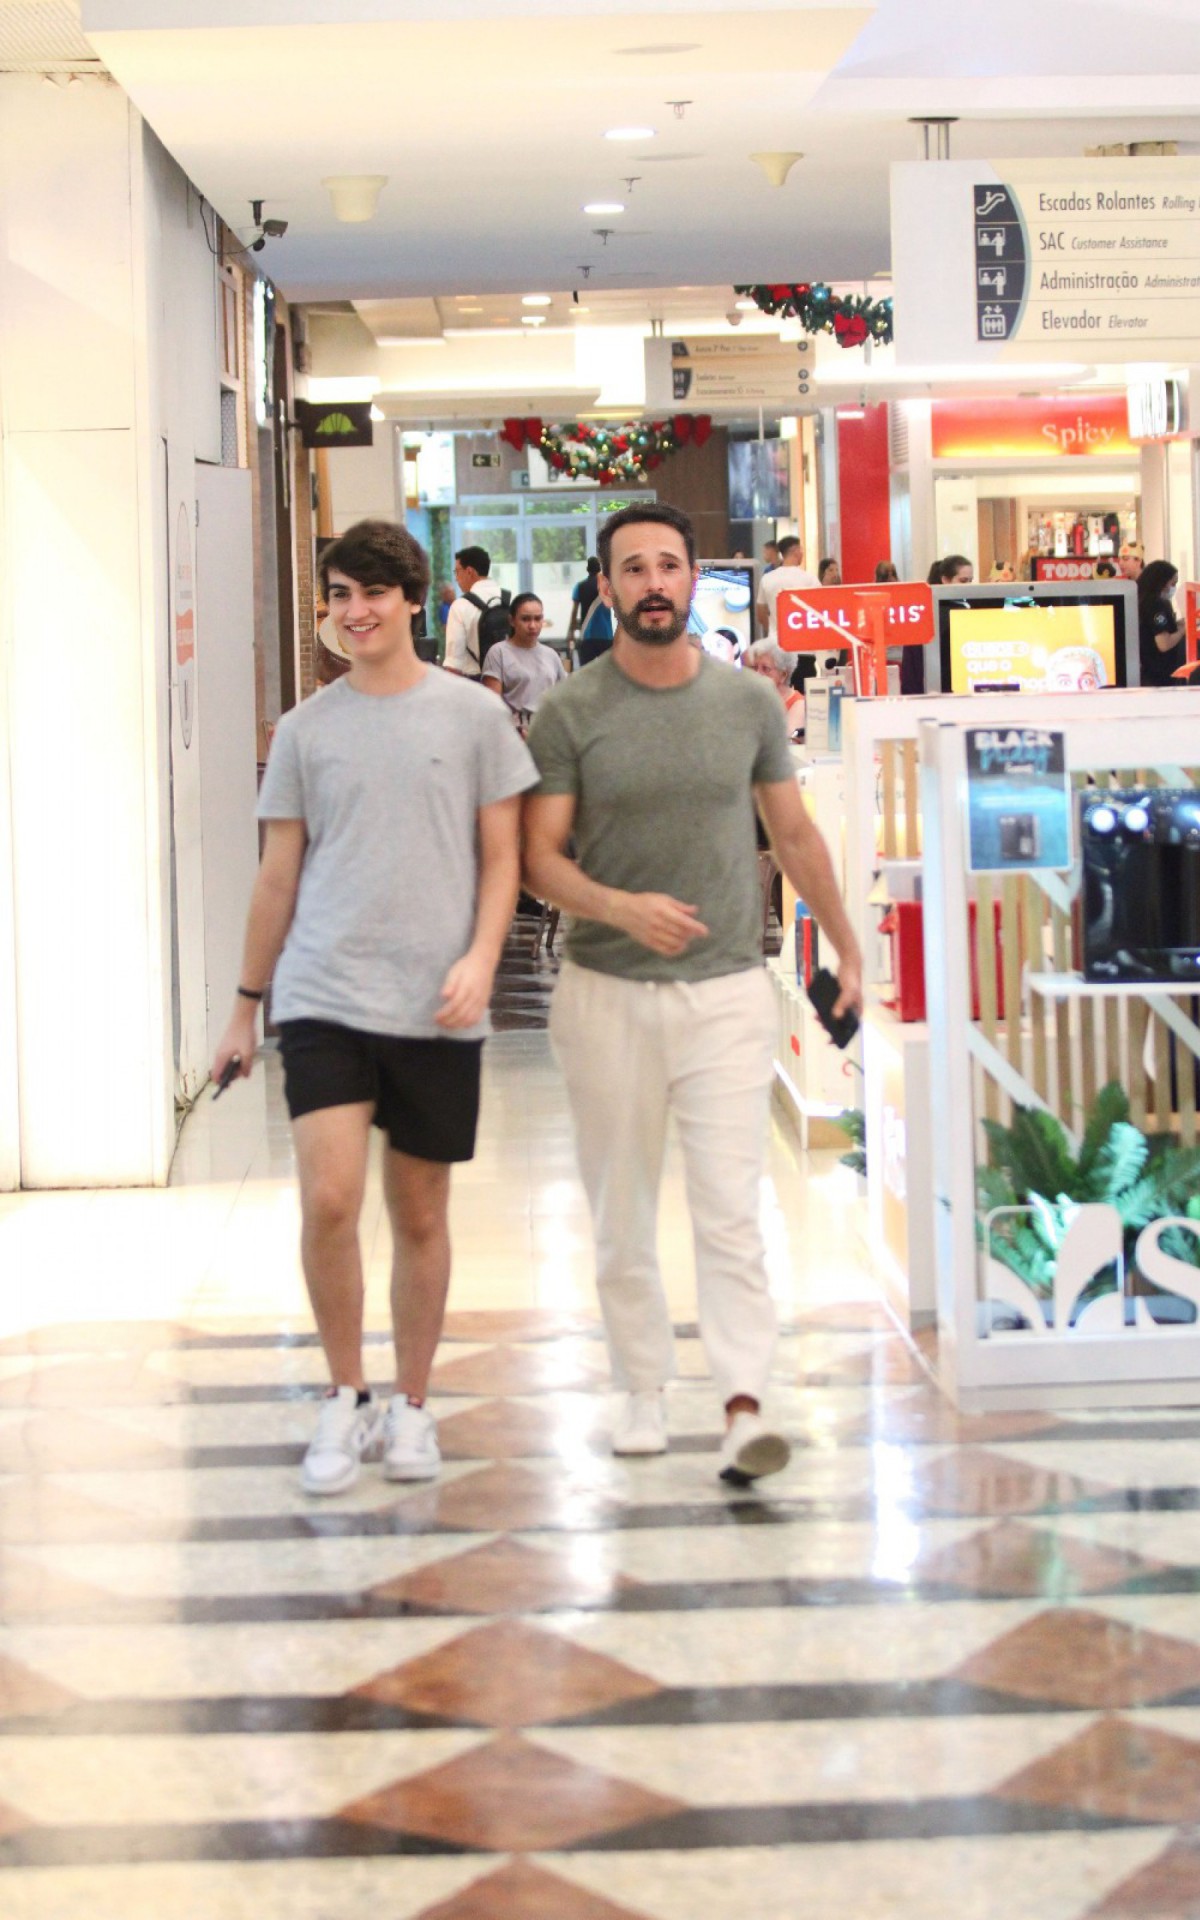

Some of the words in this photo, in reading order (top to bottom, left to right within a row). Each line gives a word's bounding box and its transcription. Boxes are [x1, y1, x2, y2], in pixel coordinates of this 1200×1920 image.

[1038, 191, 1091, 211] Escadas
[1096, 190, 1155, 210] Rolantes
[1162, 195, 1195, 212] Rolling
[1039, 231, 1065, 250] SAC
[1071, 236, 1116, 250] Customer
[1119, 235, 1168, 249] Assistance
[1040, 270, 1138, 293] Administração
[1042, 309, 1101, 330] Elevador
[1108, 314, 1148, 329] Elevator
[1041, 416, 1116, 447] Spicy
